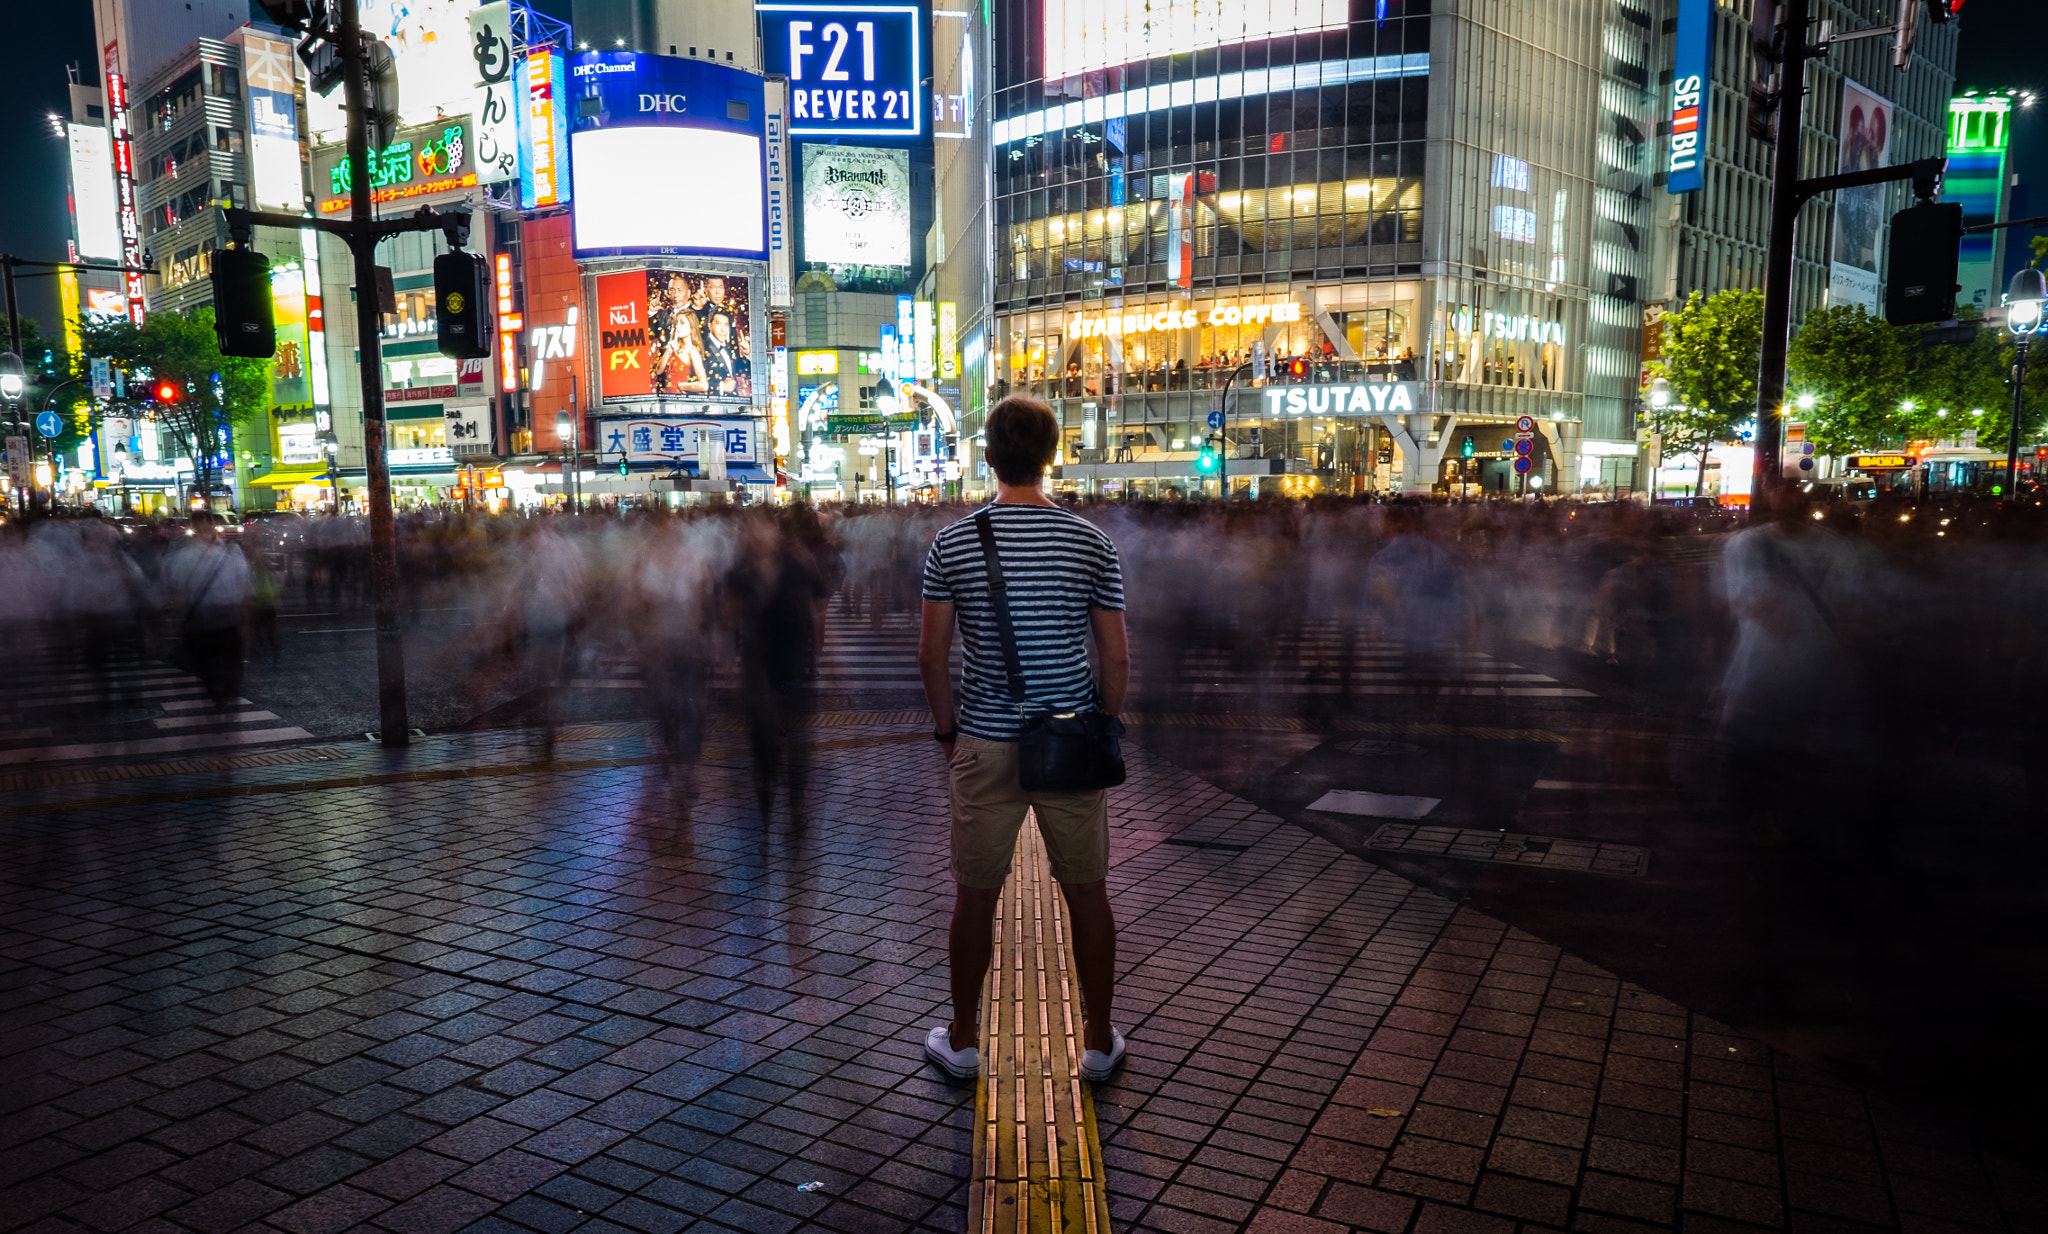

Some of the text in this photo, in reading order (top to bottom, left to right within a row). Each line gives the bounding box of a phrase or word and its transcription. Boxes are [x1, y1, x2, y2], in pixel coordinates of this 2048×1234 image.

[790, 21, 874, 81] F21
[574, 61, 636, 76] DHC Channel
[474, 23, 514, 176] もんじゃ
[638, 94, 686, 113] DHC
[883, 90, 909, 119] 21
[1670, 75, 1700, 173] SEIBU
[767, 108, 783, 251] Taisei neon
[610, 301, 637, 325] No.1
[1069, 302, 1301, 340] STARBUCKS COFFEE
[602, 328, 646, 349] DMM
[1484, 311, 1562, 346] TSUTAYA
[460, 359, 483, 378] JTB
[610, 349, 640, 371] FX
[1265, 384, 1413, 415] TSUTAYA
